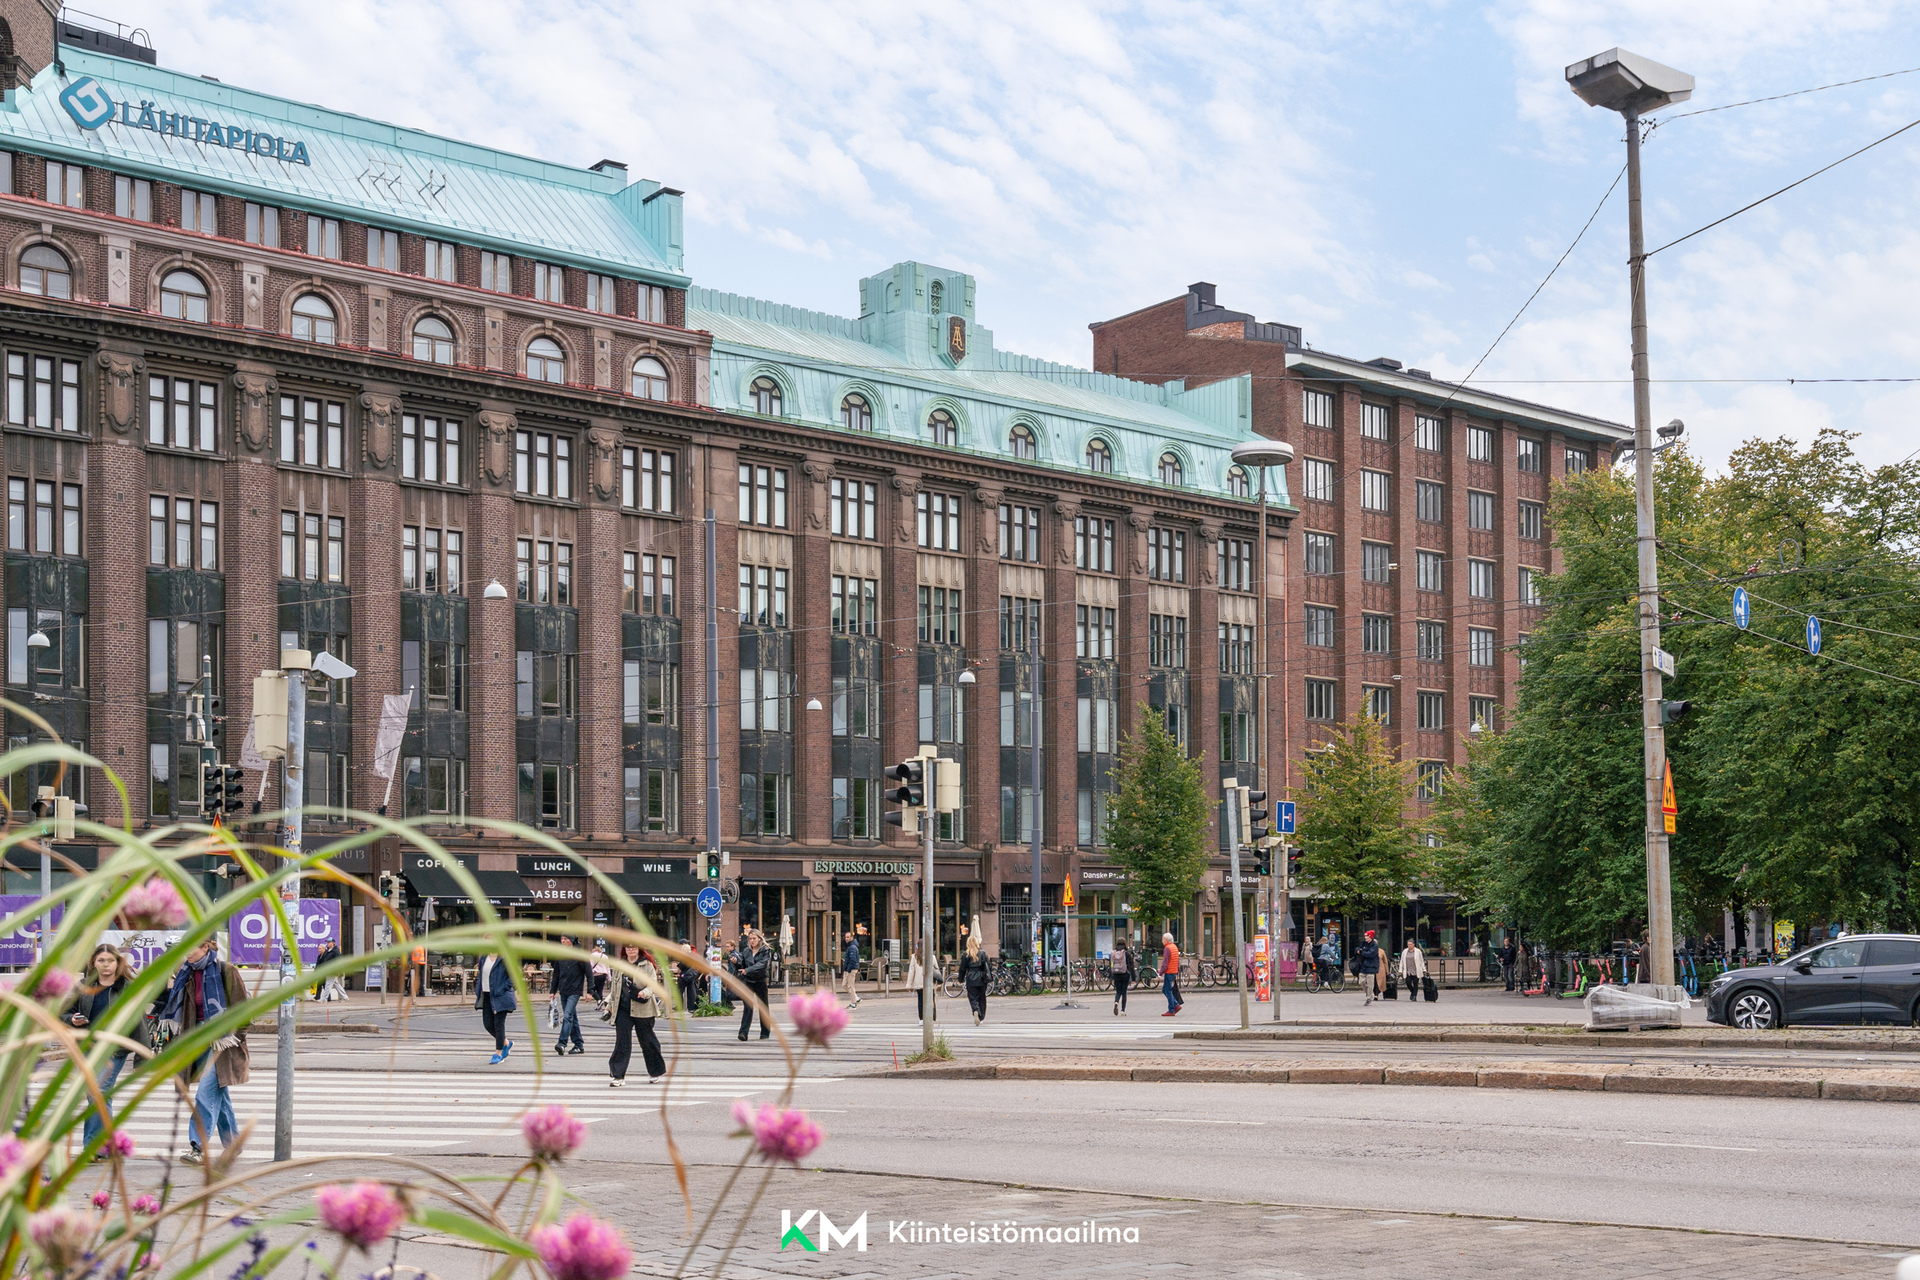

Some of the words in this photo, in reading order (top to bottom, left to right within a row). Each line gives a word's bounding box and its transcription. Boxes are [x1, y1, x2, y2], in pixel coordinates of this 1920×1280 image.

[122, 100, 311, 166] LÄHITAPIOLA
[417, 859, 465, 868] COFE
[534, 862, 571, 871] LUNCH
[814, 860, 873, 874] ESPRESSO
[874, 862, 916, 875] HOUSE
[643, 864, 672, 873] WINE
[1225, 875, 1248, 883] Dake
[530, 890, 583, 899] ASBERG
